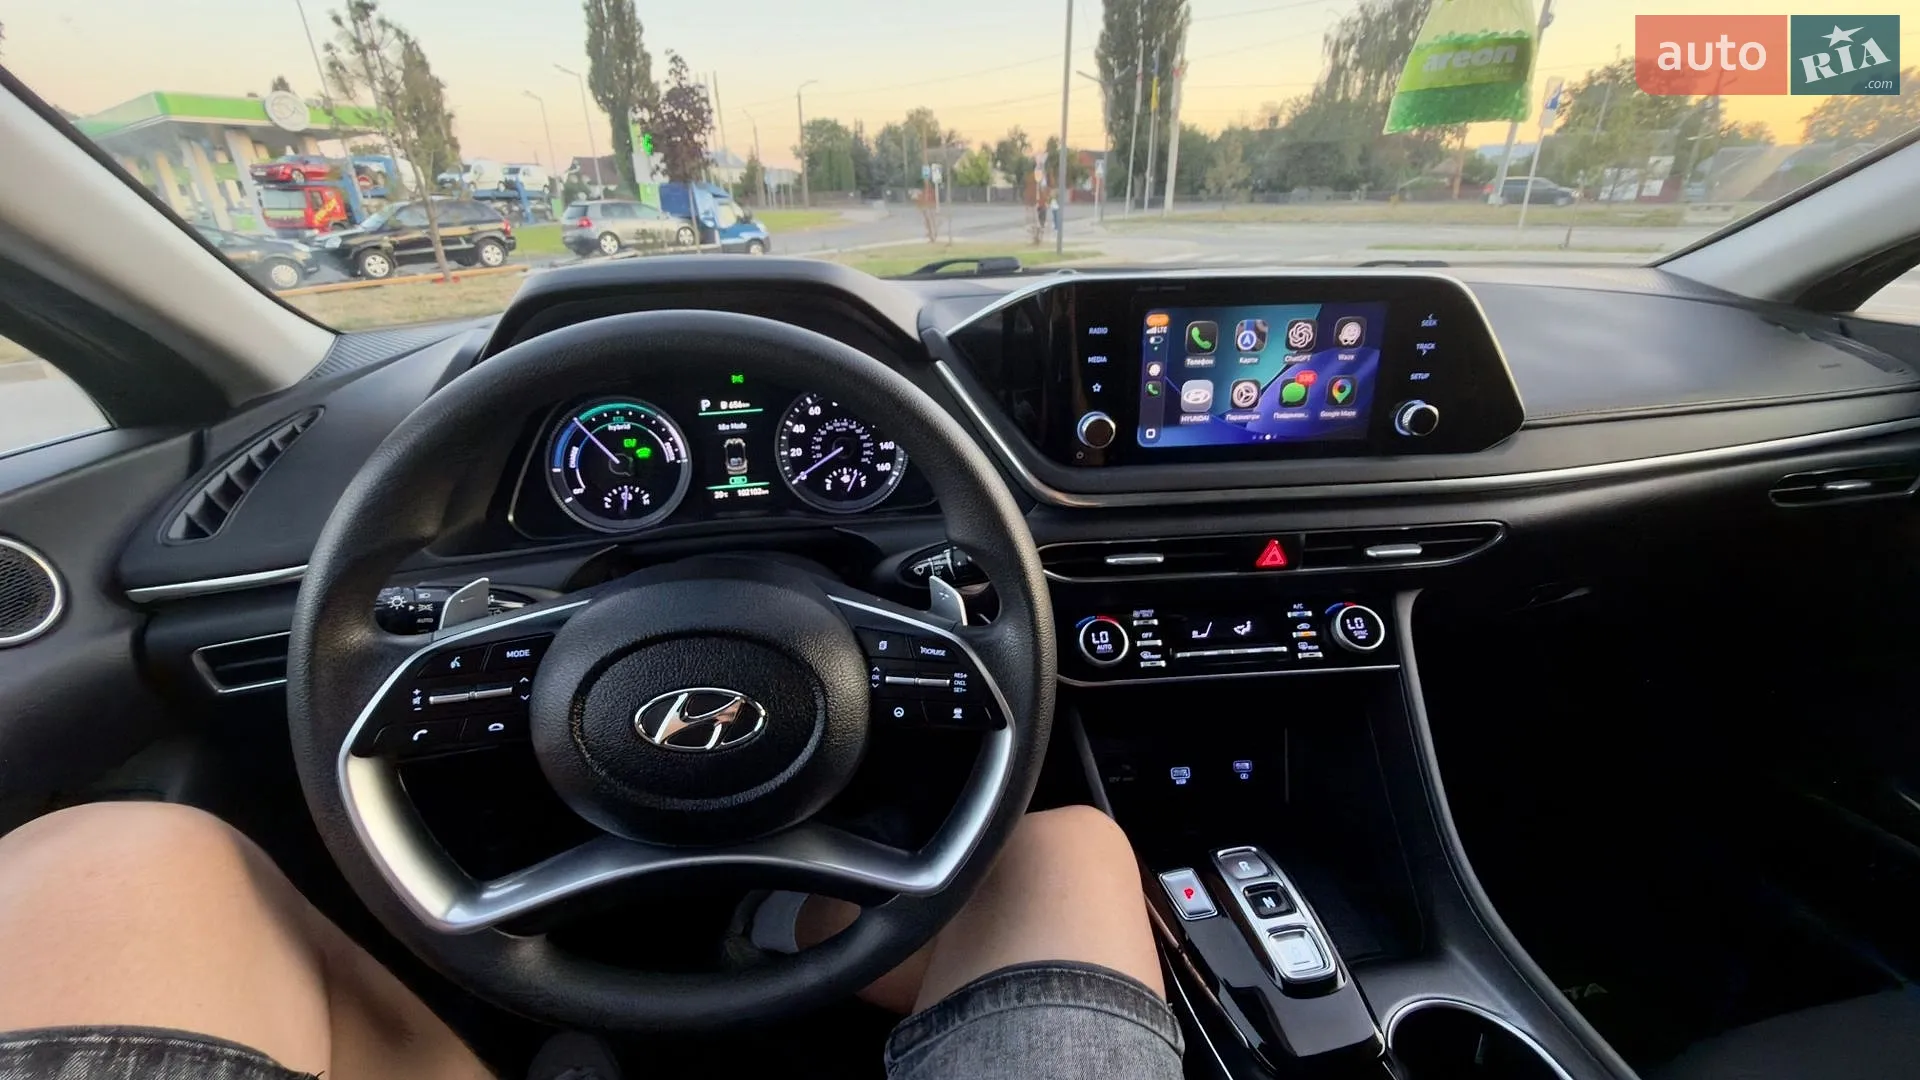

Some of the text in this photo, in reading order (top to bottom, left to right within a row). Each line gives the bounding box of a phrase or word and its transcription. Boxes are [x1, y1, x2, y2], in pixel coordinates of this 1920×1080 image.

[1423, 45, 1517, 73] areon
[1088, 327, 1109, 335] RADIO
[1087, 356, 1108, 364] MEDIA
[1410, 372, 1431, 381] SETUP
[700, 399, 711, 412] P
[808, 405, 822, 416] 60
[1180, 415, 1210, 423] HYUNDAI
[607, 423, 631, 431] hybrid
[792, 423, 806, 434] 40
[879, 440, 895, 451] 140
[790, 447, 803, 457] 20
[875, 462, 891, 472] 160
[1345, 616, 1366, 630] LO
[1091, 630, 1109, 644] LO
[1096, 643, 1113, 651] AUTO
[506, 649, 531, 659] MODE
[1238, 860, 1251, 872] R
[1183, 887, 1195, 900] P
[1261, 896, 1277, 909] N
